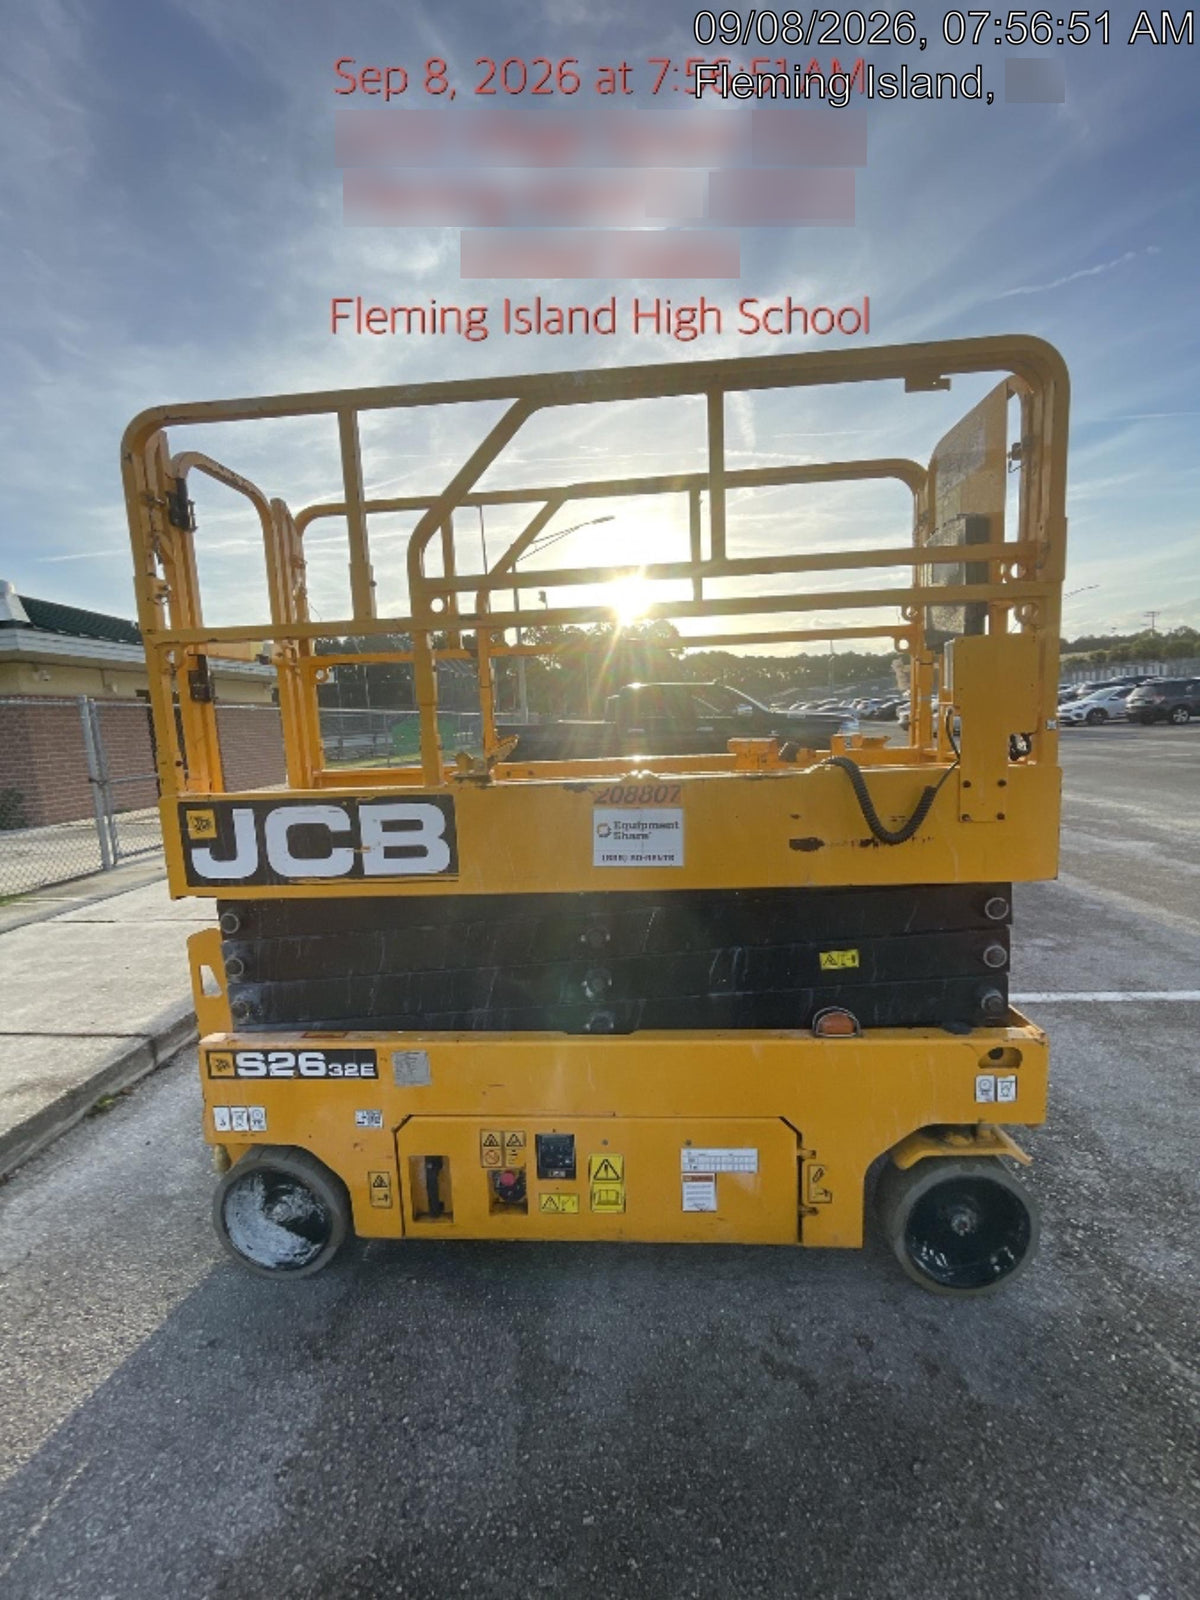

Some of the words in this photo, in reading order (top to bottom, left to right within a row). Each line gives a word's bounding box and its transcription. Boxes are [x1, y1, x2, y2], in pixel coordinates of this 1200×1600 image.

[592, 783, 682, 805] 208807
[613, 821, 679, 832] Equipment
[191, 802, 451, 880] JCB
